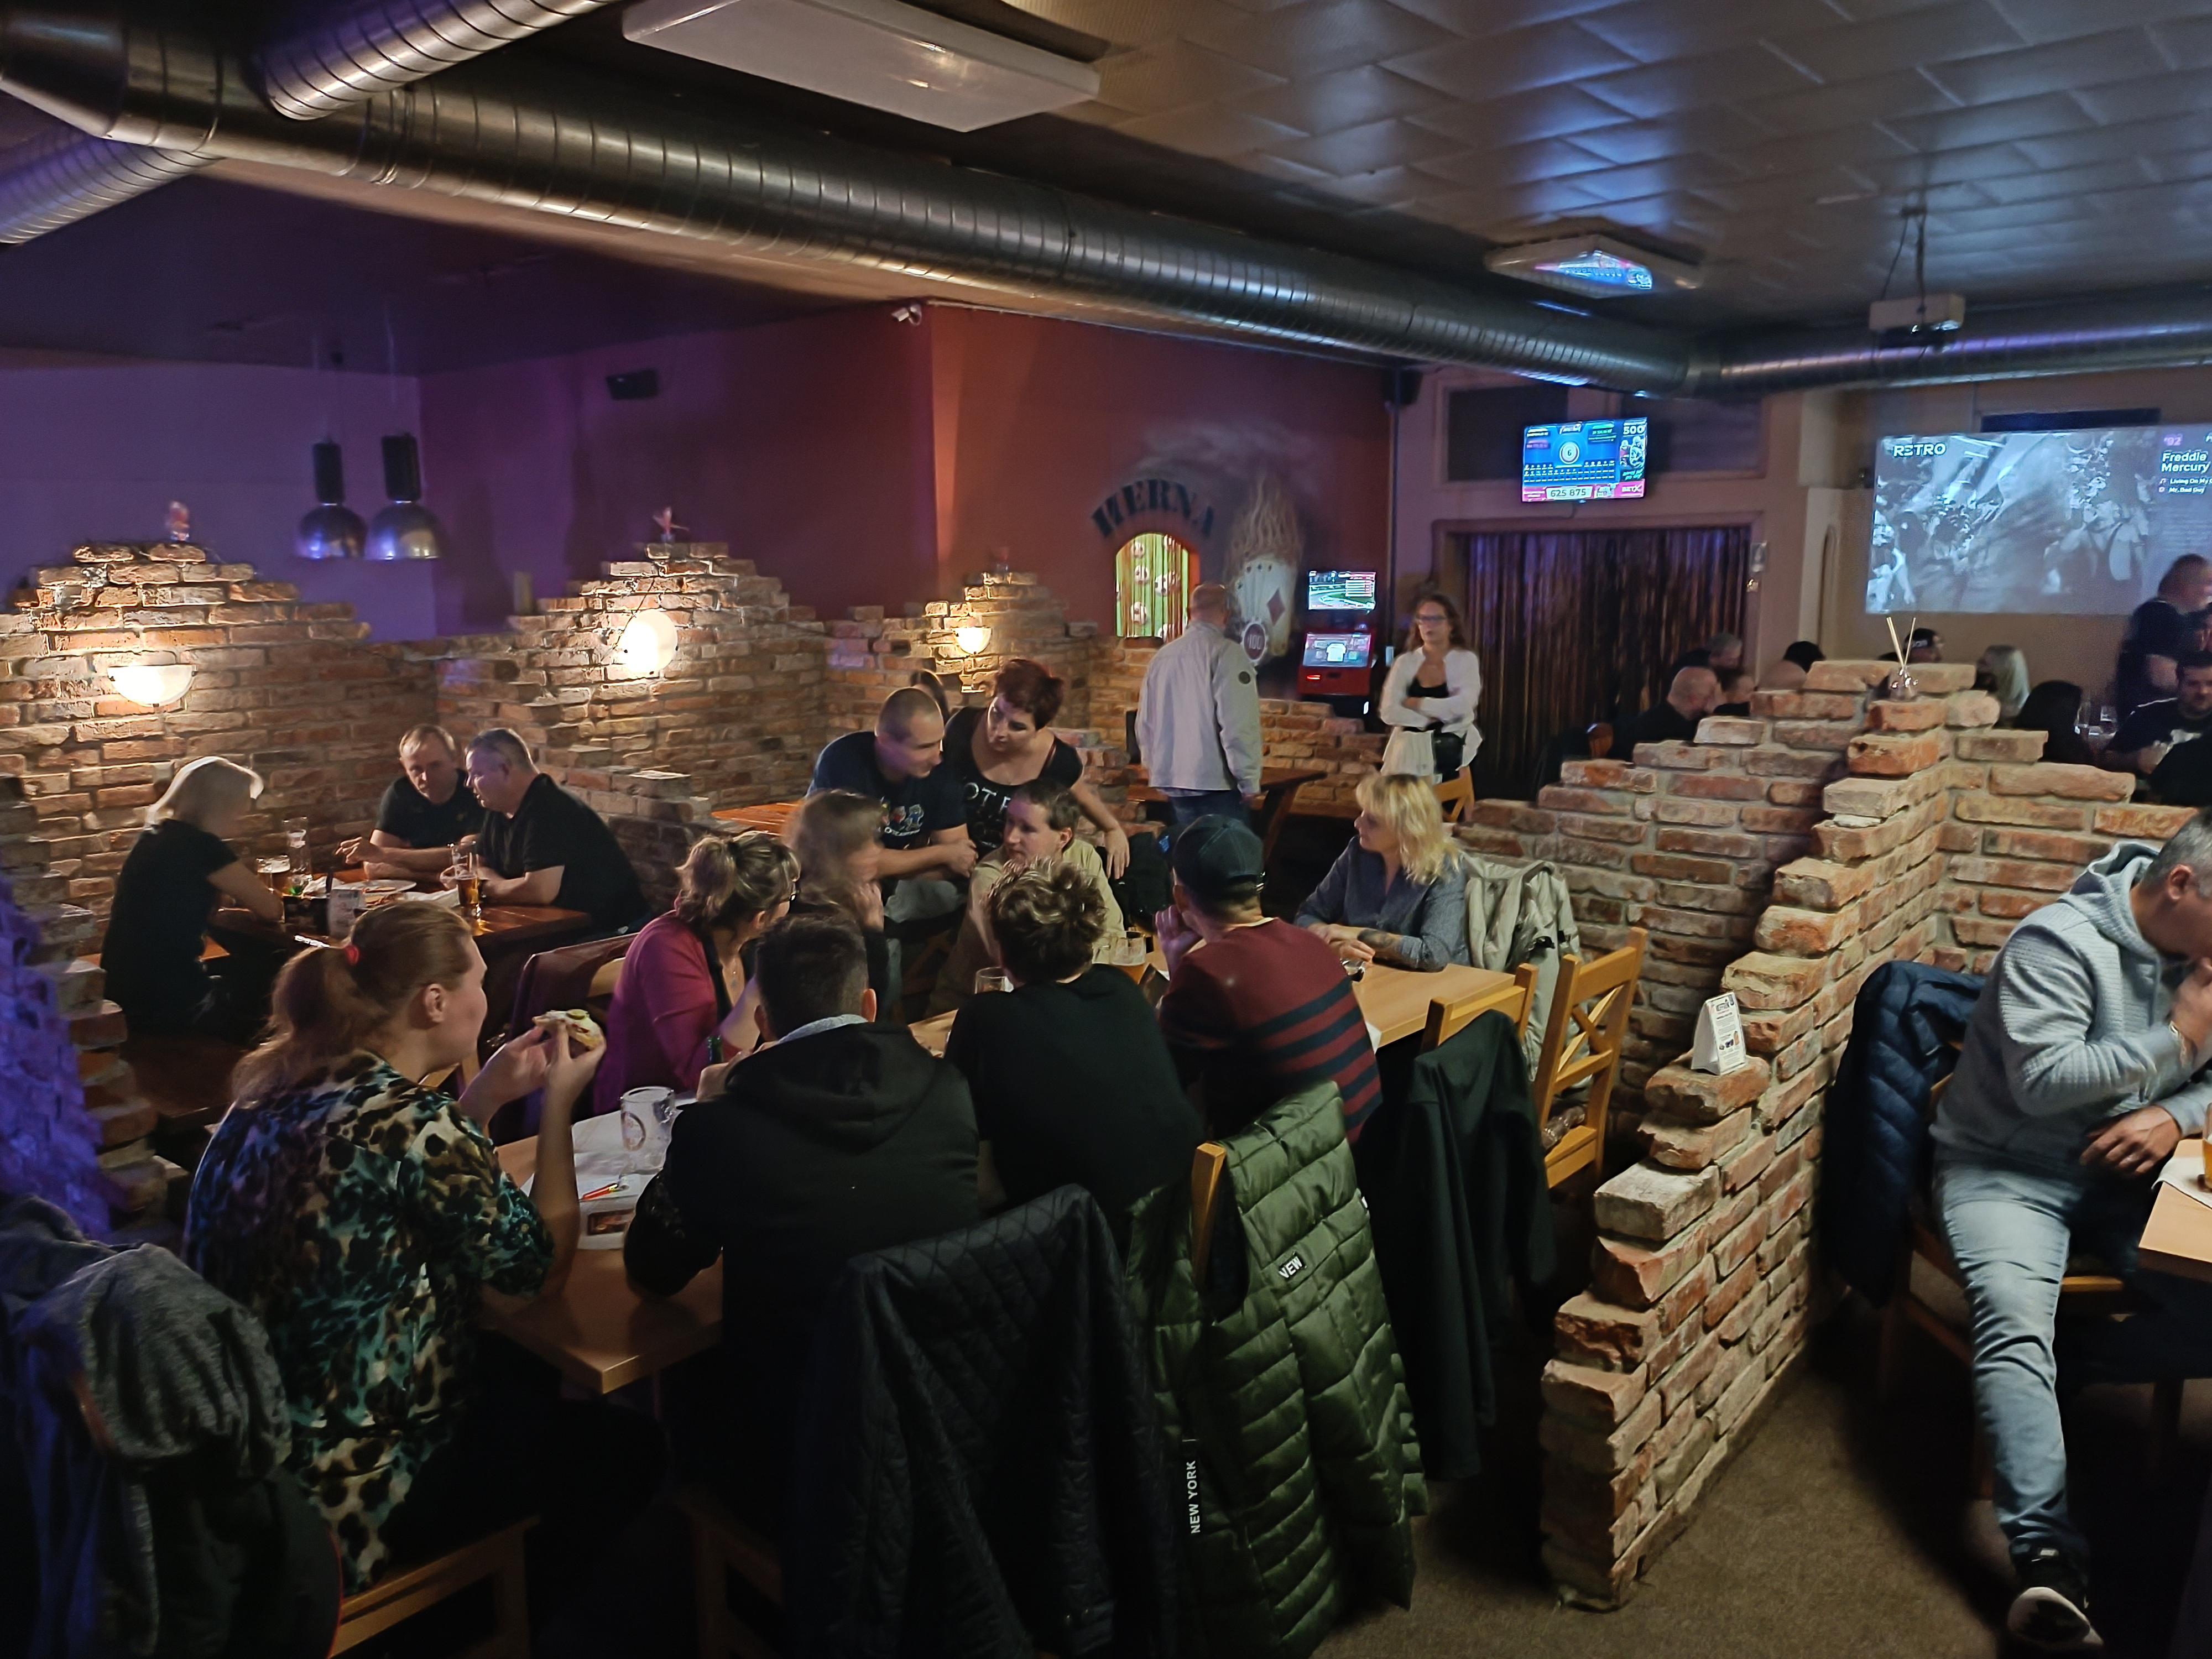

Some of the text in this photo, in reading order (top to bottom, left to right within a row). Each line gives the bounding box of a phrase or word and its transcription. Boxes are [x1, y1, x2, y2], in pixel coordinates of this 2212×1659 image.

[1623, 425, 1645, 435] 500
[1893, 443, 1946, 457] RETRO
[2162, 452, 2207, 462] Freddie
[2161, 462, 2211, 474] Mercury
[1569, 488, 1586, 497] 875
[1186, 1460, 1201, 1534] NEW YORK
